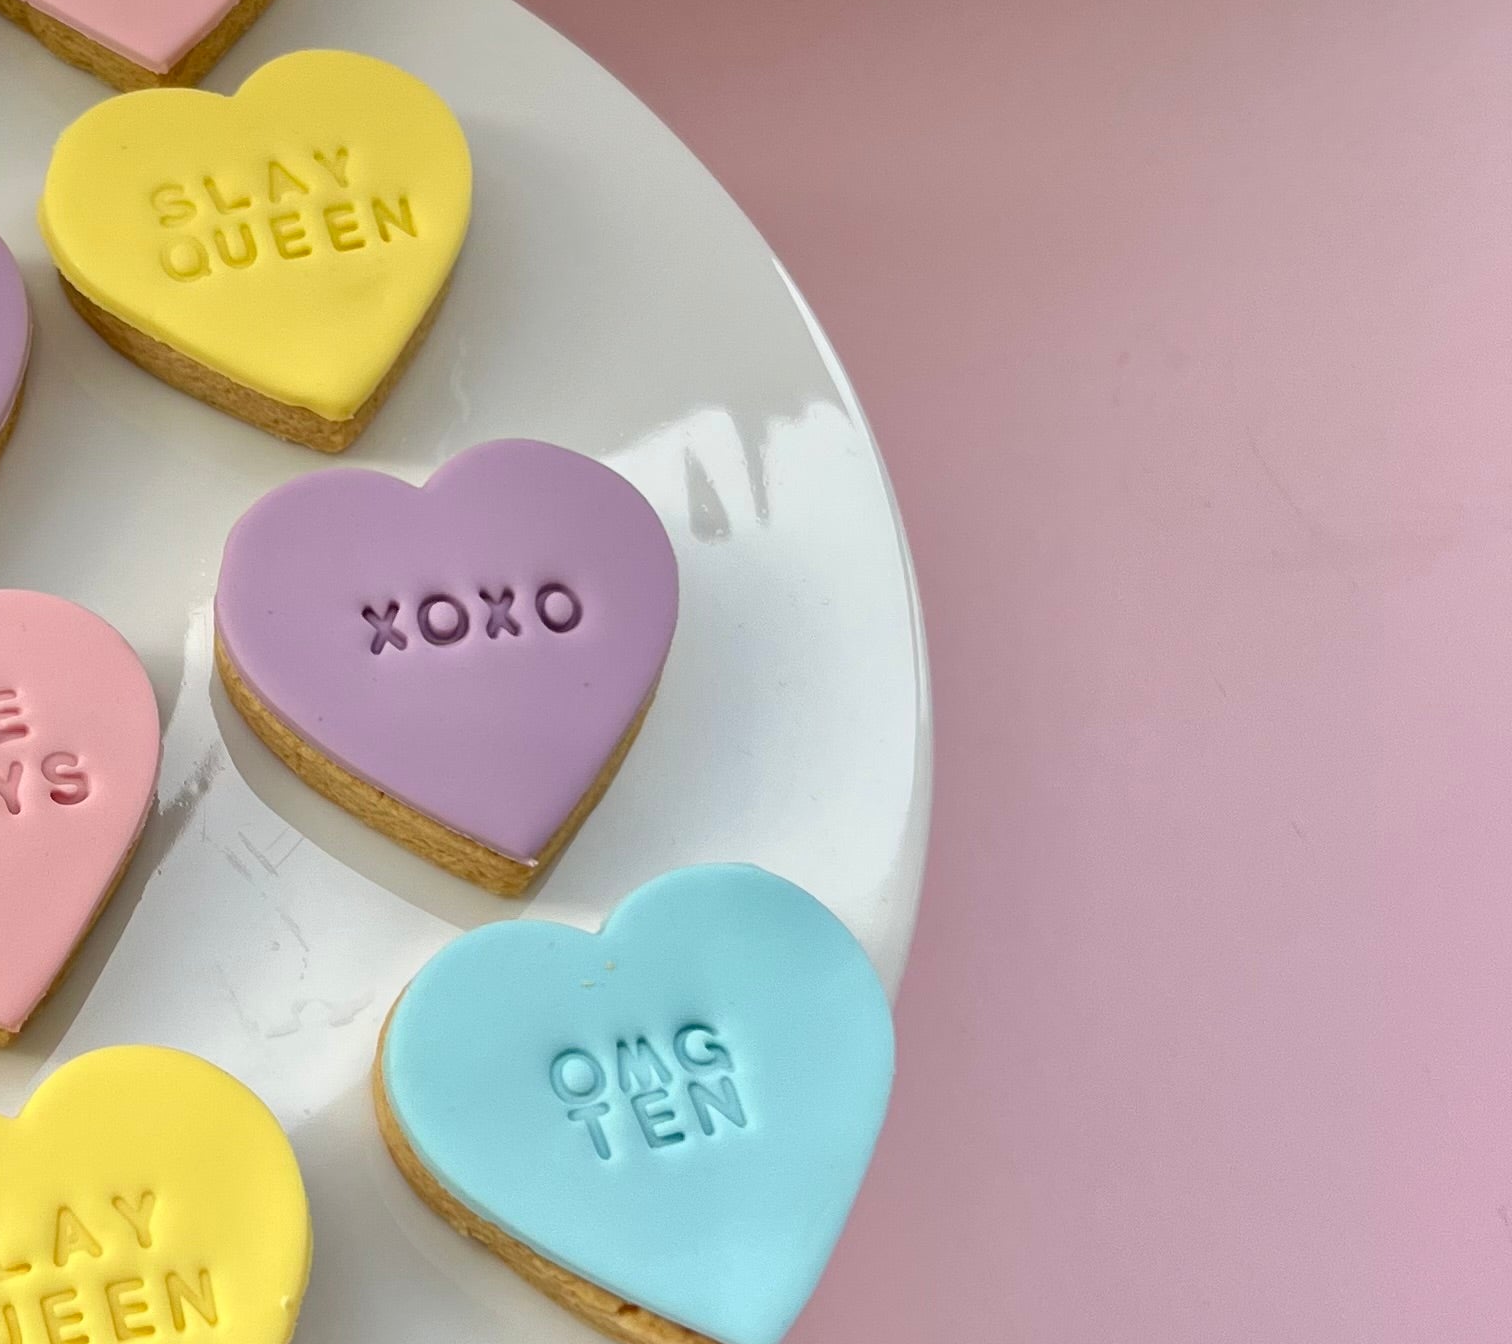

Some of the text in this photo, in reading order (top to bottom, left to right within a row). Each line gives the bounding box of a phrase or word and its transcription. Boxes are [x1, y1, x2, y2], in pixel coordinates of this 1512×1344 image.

[148, 145, 354, 228] SLAY
[155, 195, 419, 282] QUEEN
[360, 581, 584, 656] XOXO
[548, 1021, 733, 1104] OMG
[567, 1076, 751, 1161] TEN
